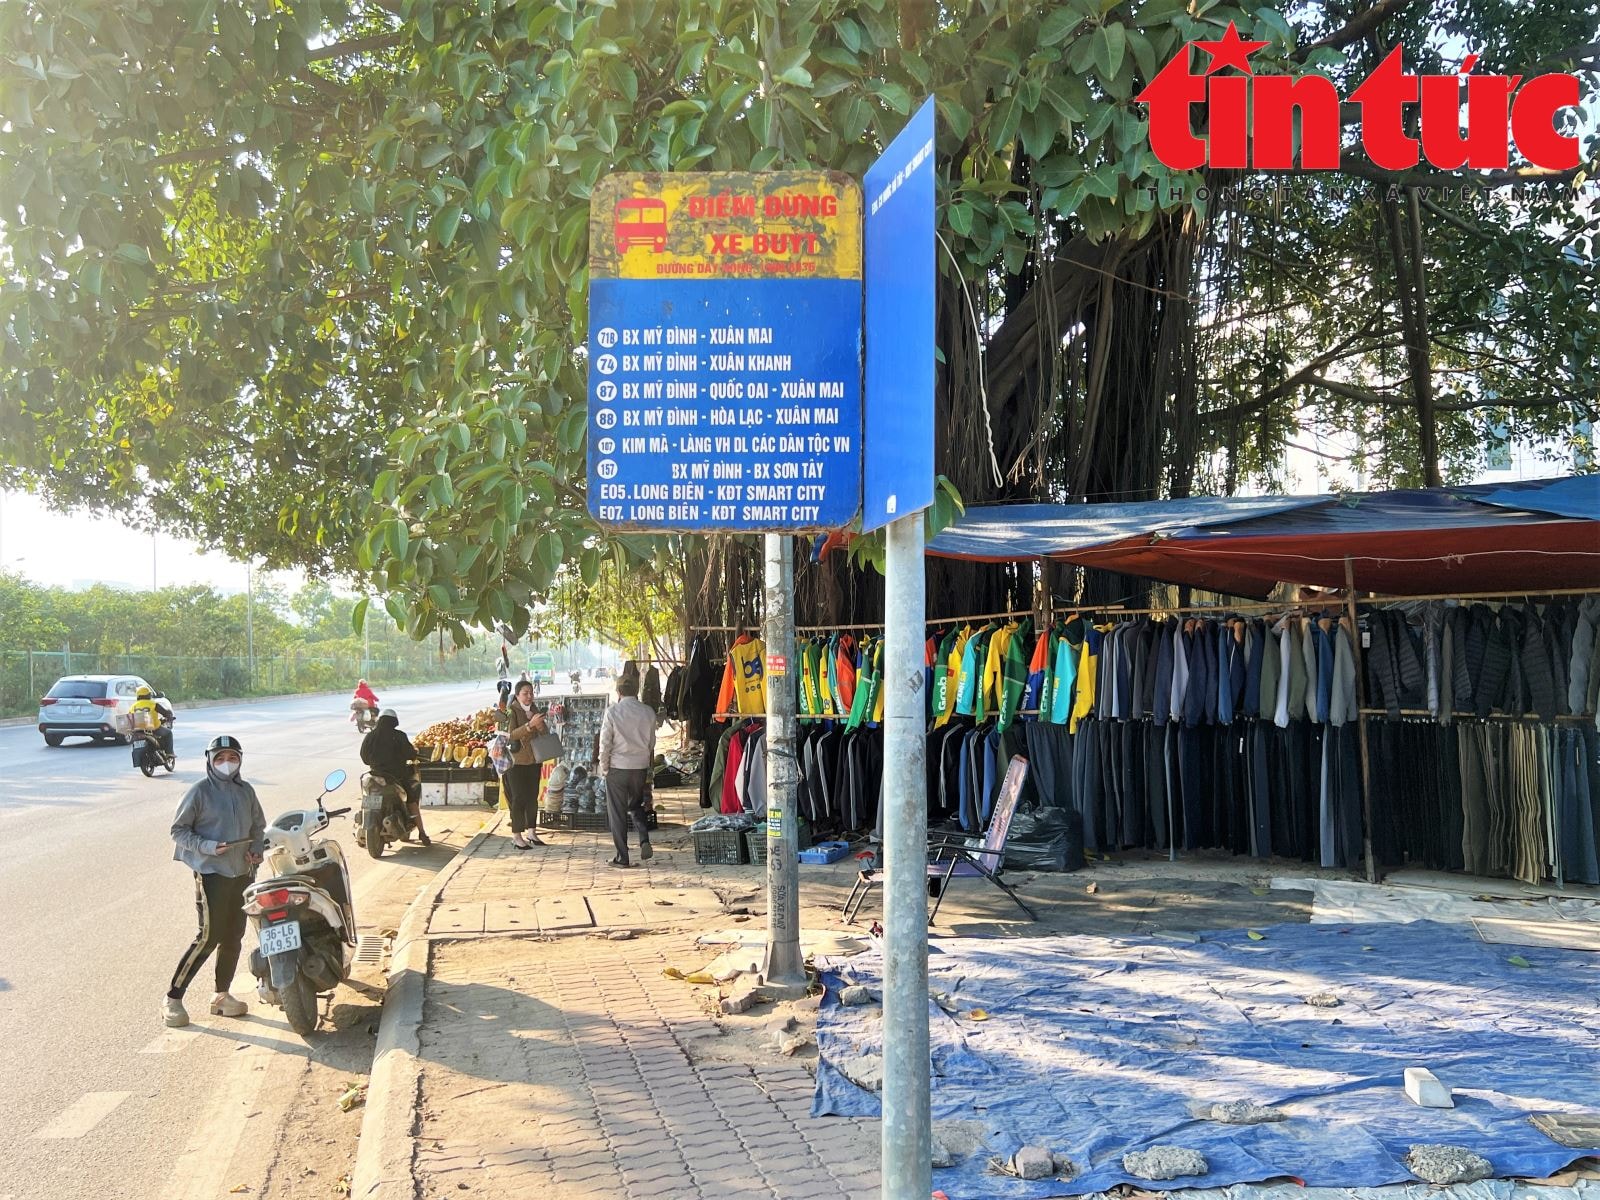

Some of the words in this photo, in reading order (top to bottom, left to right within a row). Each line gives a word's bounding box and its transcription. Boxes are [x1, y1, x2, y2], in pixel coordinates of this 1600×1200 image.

[688, 187, 756, 218] ĐIỂM
[711, 232, 744, 256] XE
[600, 332, 615, 345] 71B
[623, 329, 639, 345] BX
[644, 326, 662, 344] MỸ
[667, 326, 697, 344] ĐÌNH
[710, 325, 744, 344] XUÂN
[748, 328, 772, 344] MAI
[599, 358, 615, 371] 74
[623, 356, 639, 371] BX
[644, 352, 662, 371] MỸ
[667, 352, 697, 371] ĐÌNH
[710, 352, 744, 371] XUÂN
[748, 355, 791, 371] KHANH
[599, 385, 615, 398] 87
[623, 383, 639, 399] BX
[644, 379, 663, 398] MỸ
[667, 379, 697, 398] ĐÌNH
[710, 378, 744, 400] QUỐC
[748, 383, 768, 398] OAI
[781, 379, 815, 398] XUÂN
[820, 383, 843, 398] MAI
[599, 413, 614, 426] 88
[624, 410, 640, 425] BX
[644, 407, 663, 425] MỸ
[667, 407, 697, 425] ĐÌNH
[711, 407, 735, 425] HÒA
[740, 409, 762, 428] LẠC
[776, 405, 810, 424] XUÂN
[815, 408, 838, 424] MAI
[623, 438, 645, 453] KIM
[681, 433, 711, 452] LÀNG
[715, 437, 730, 452] VH
[734, 437, 748, 452] DL
[752, 434, 775, 452] CÁC
[780, 433, 804, 452] DÂN
[808, 433, 829, 455] TỘC
[834, 437, 849, 452] VN
[600, 463, 615, 476] 157
[672, 464, 687, 479] BX
[692, 460, 710, 479] MỸ
[713, 460, 742, 479] ĐÌNH
[754, 464, 769, 479] BX
[774, 462, 798, 479] SƠN
[802, 459, 823, 478] TÂY
[634, 485, 668, 500] LONG
[673, 481, 704, 500] BIÊN
[718, 485, 742, 500] KĐT
[747, 486, 793, 500] SMART
[797, 486, 826, 500] CITY
[630, 506, 664, 520] LONG
[669, 502, 698, 520] BIÊN
[712, 506, 736, 520] KĐT
[743, 506, 787, 520] SMART
[792, 506, 820, 520] CITY
[938, 676, 947, 711] Grab
[265, 924, 294, 941] 36-L6
[263, 936, 298, 955] 049.51
